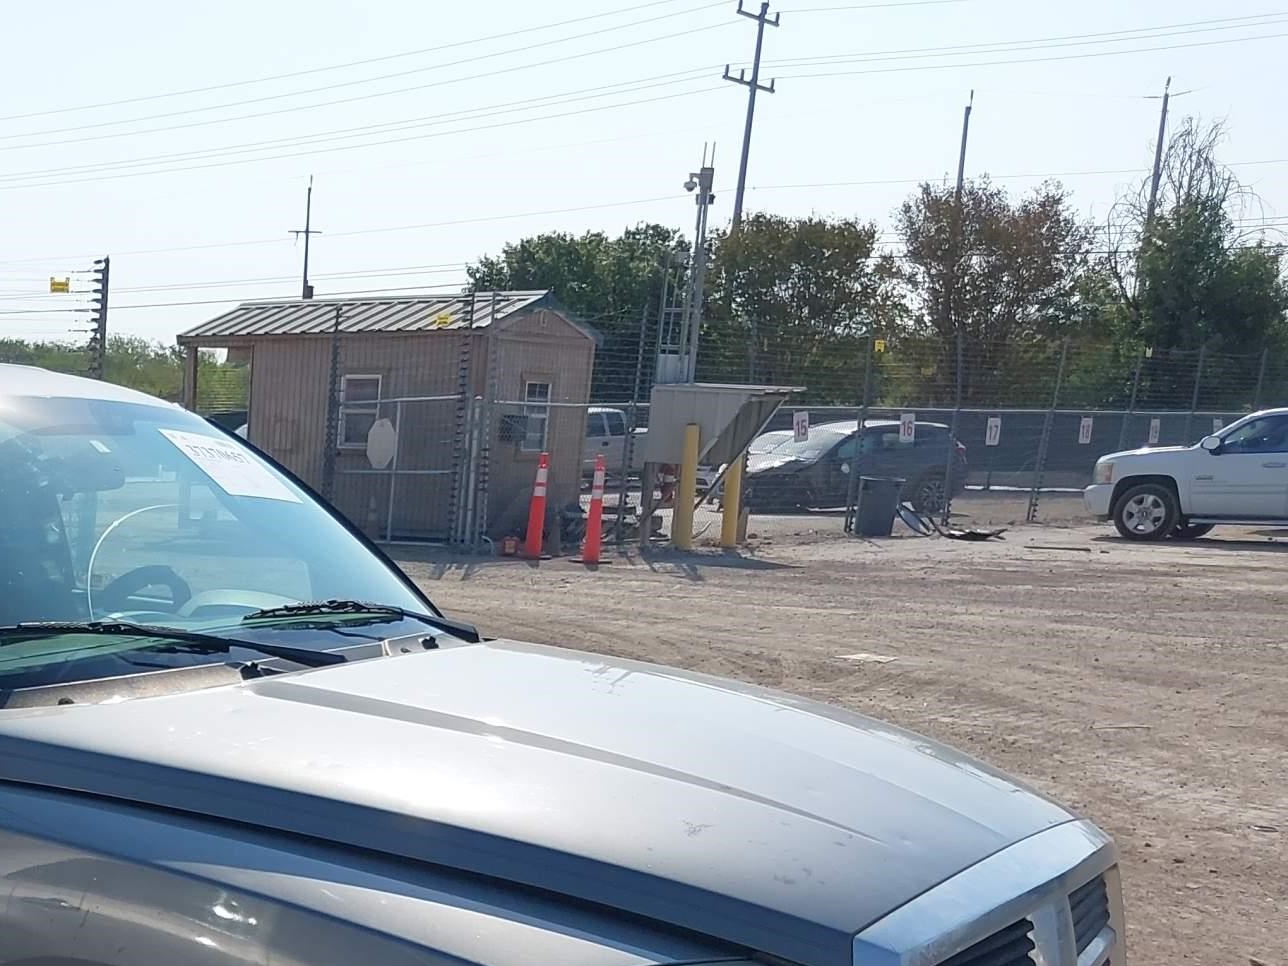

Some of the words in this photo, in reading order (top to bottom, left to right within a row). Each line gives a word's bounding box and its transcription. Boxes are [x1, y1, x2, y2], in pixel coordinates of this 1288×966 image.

[795, 420, 808, 437] 15
[902, 421, 913, 437] 16
[989, 424, 999, 440] 17
